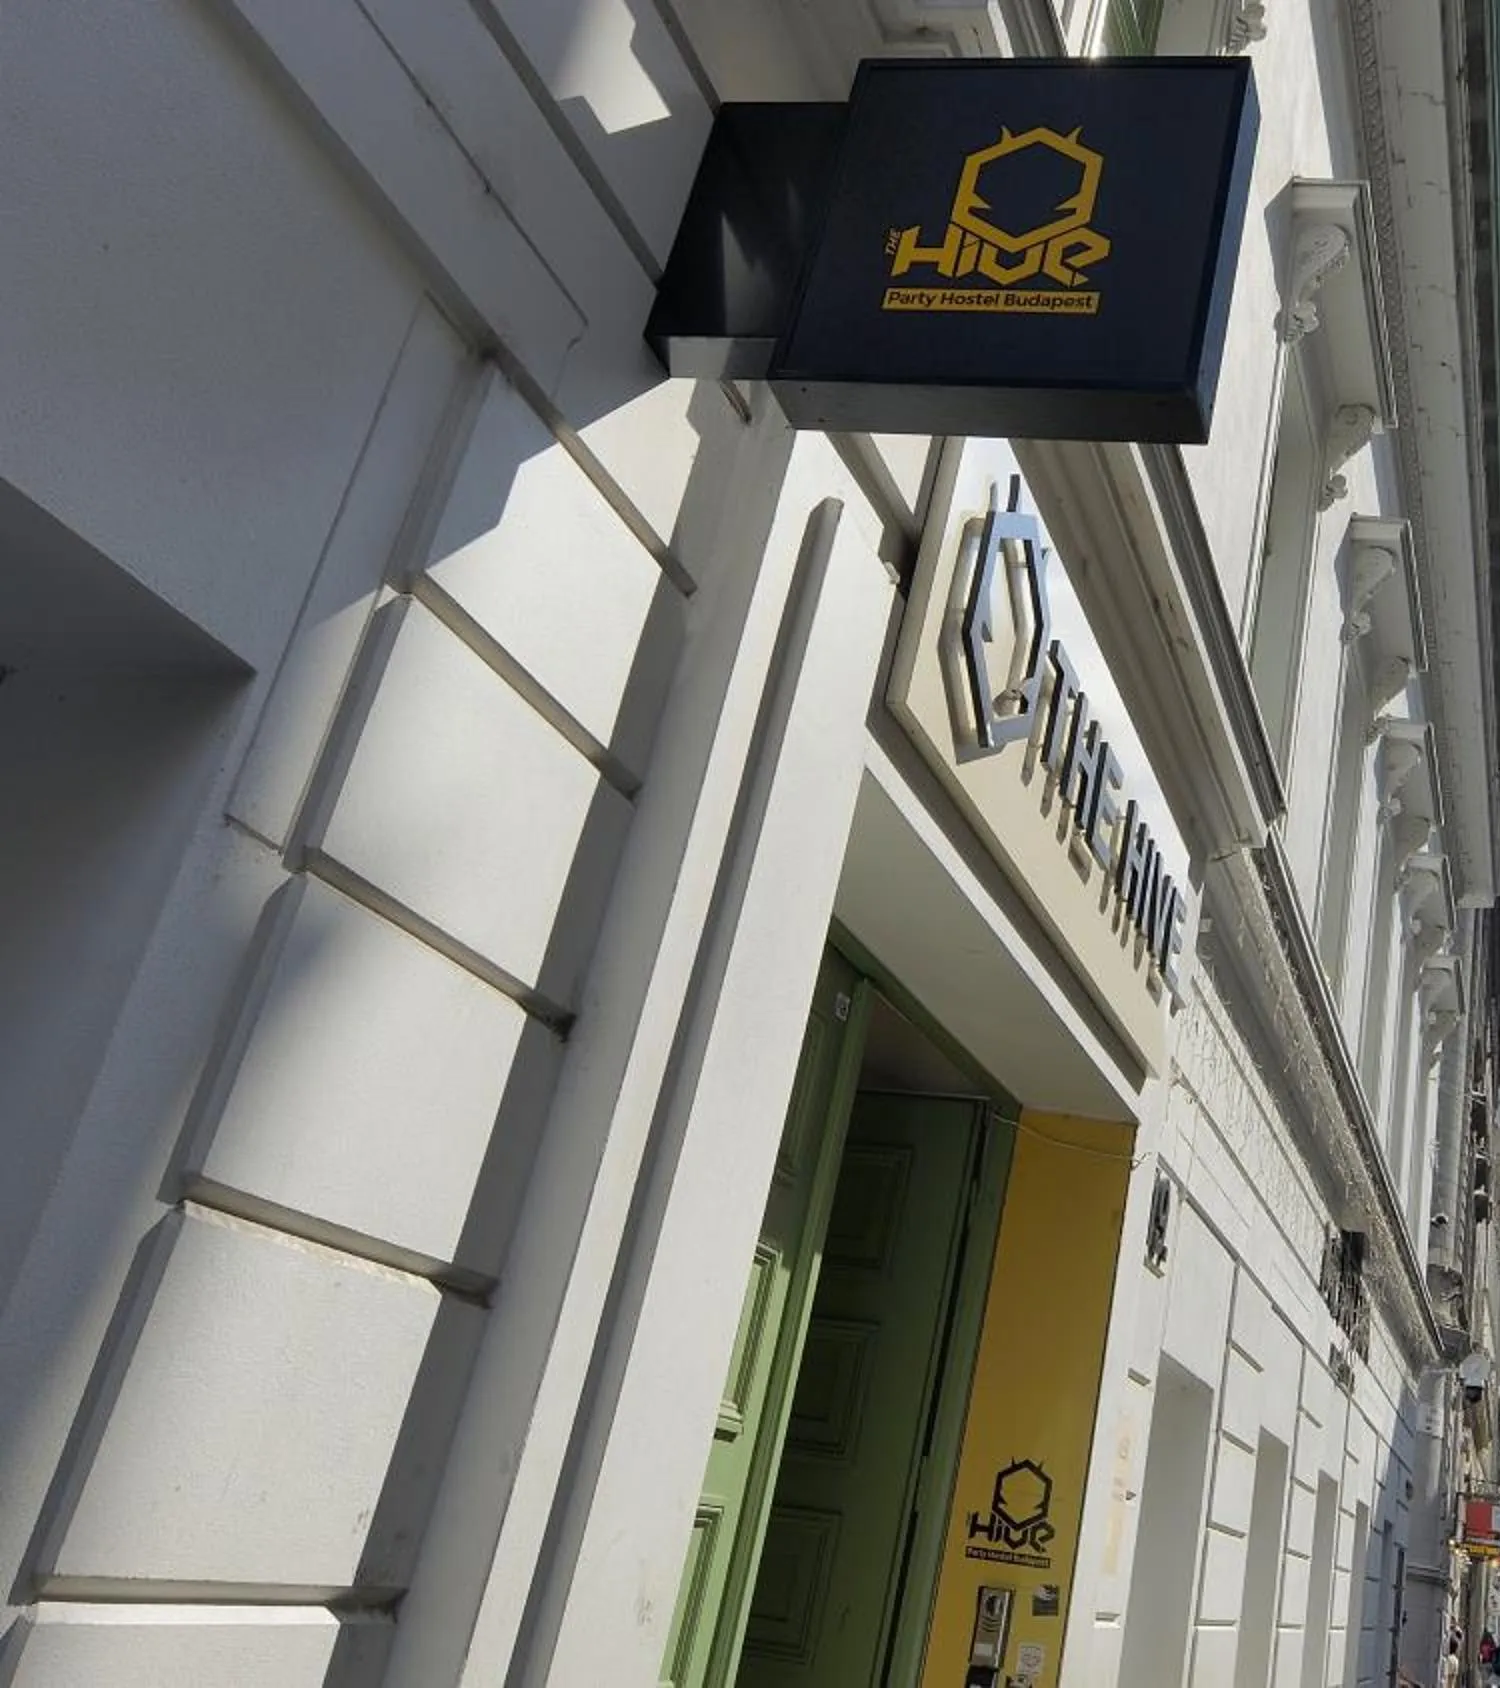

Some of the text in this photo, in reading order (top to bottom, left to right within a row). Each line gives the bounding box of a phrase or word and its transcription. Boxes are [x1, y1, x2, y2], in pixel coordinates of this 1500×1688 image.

[884, 228, 901, 255] THE
[888, 291, 1094, 310] Party Hostel Budapest
[1040, 640, 1188, 1014] THE HIVE
